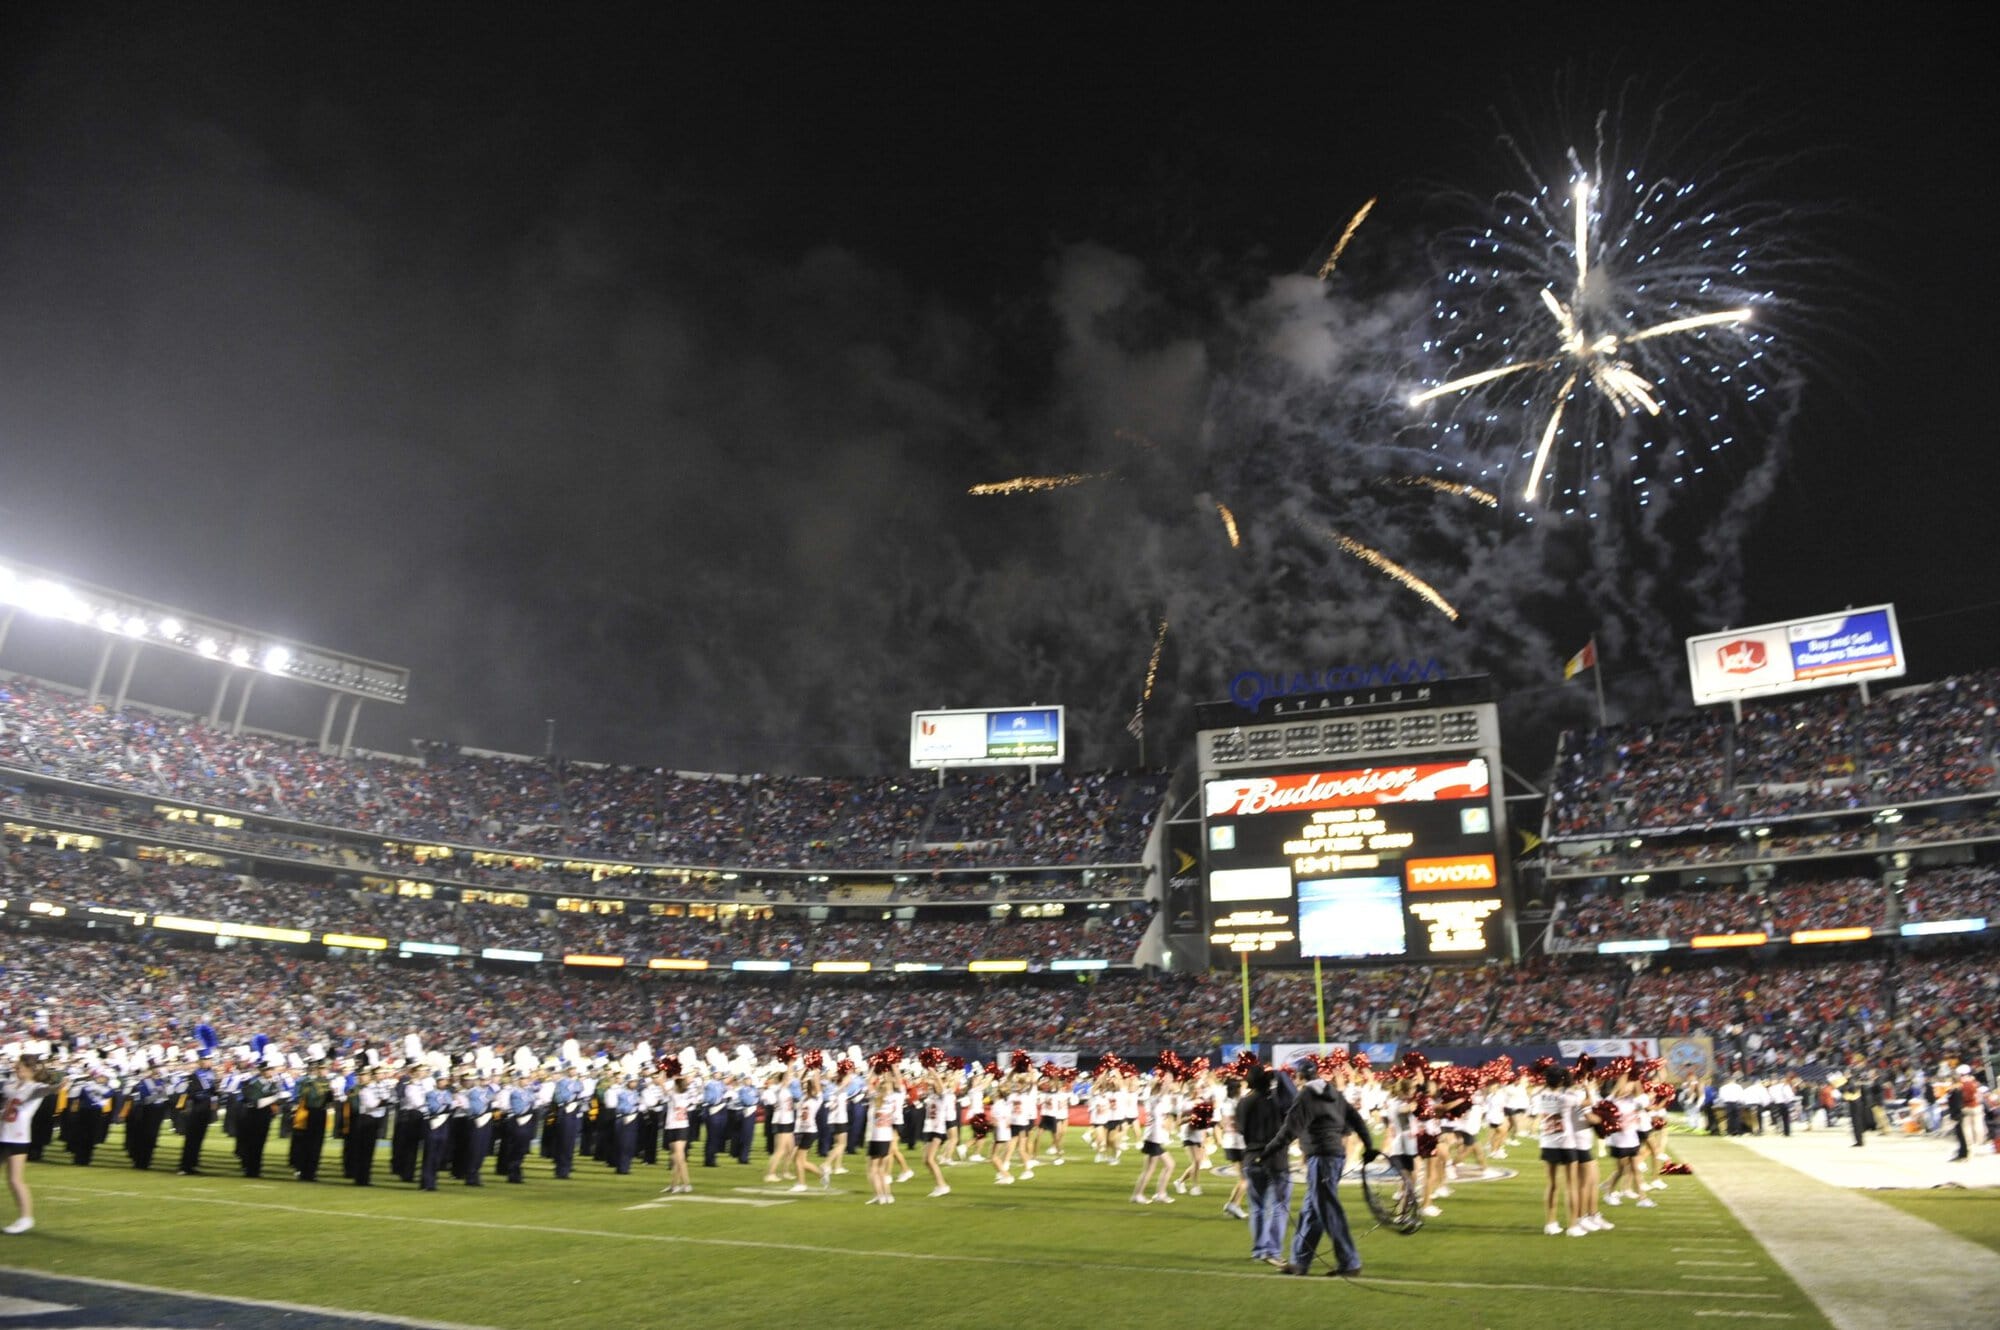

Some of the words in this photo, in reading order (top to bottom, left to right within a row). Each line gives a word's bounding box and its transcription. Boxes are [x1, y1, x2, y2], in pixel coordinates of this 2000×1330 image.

[1229, 656, 1445, 713] QUALCOMM
[1273, 687, 1431, 712] STADIUM
[1237, 767, 1416, 815] Budweiser
[1411, 864, 1491, 884] TOYOTA
